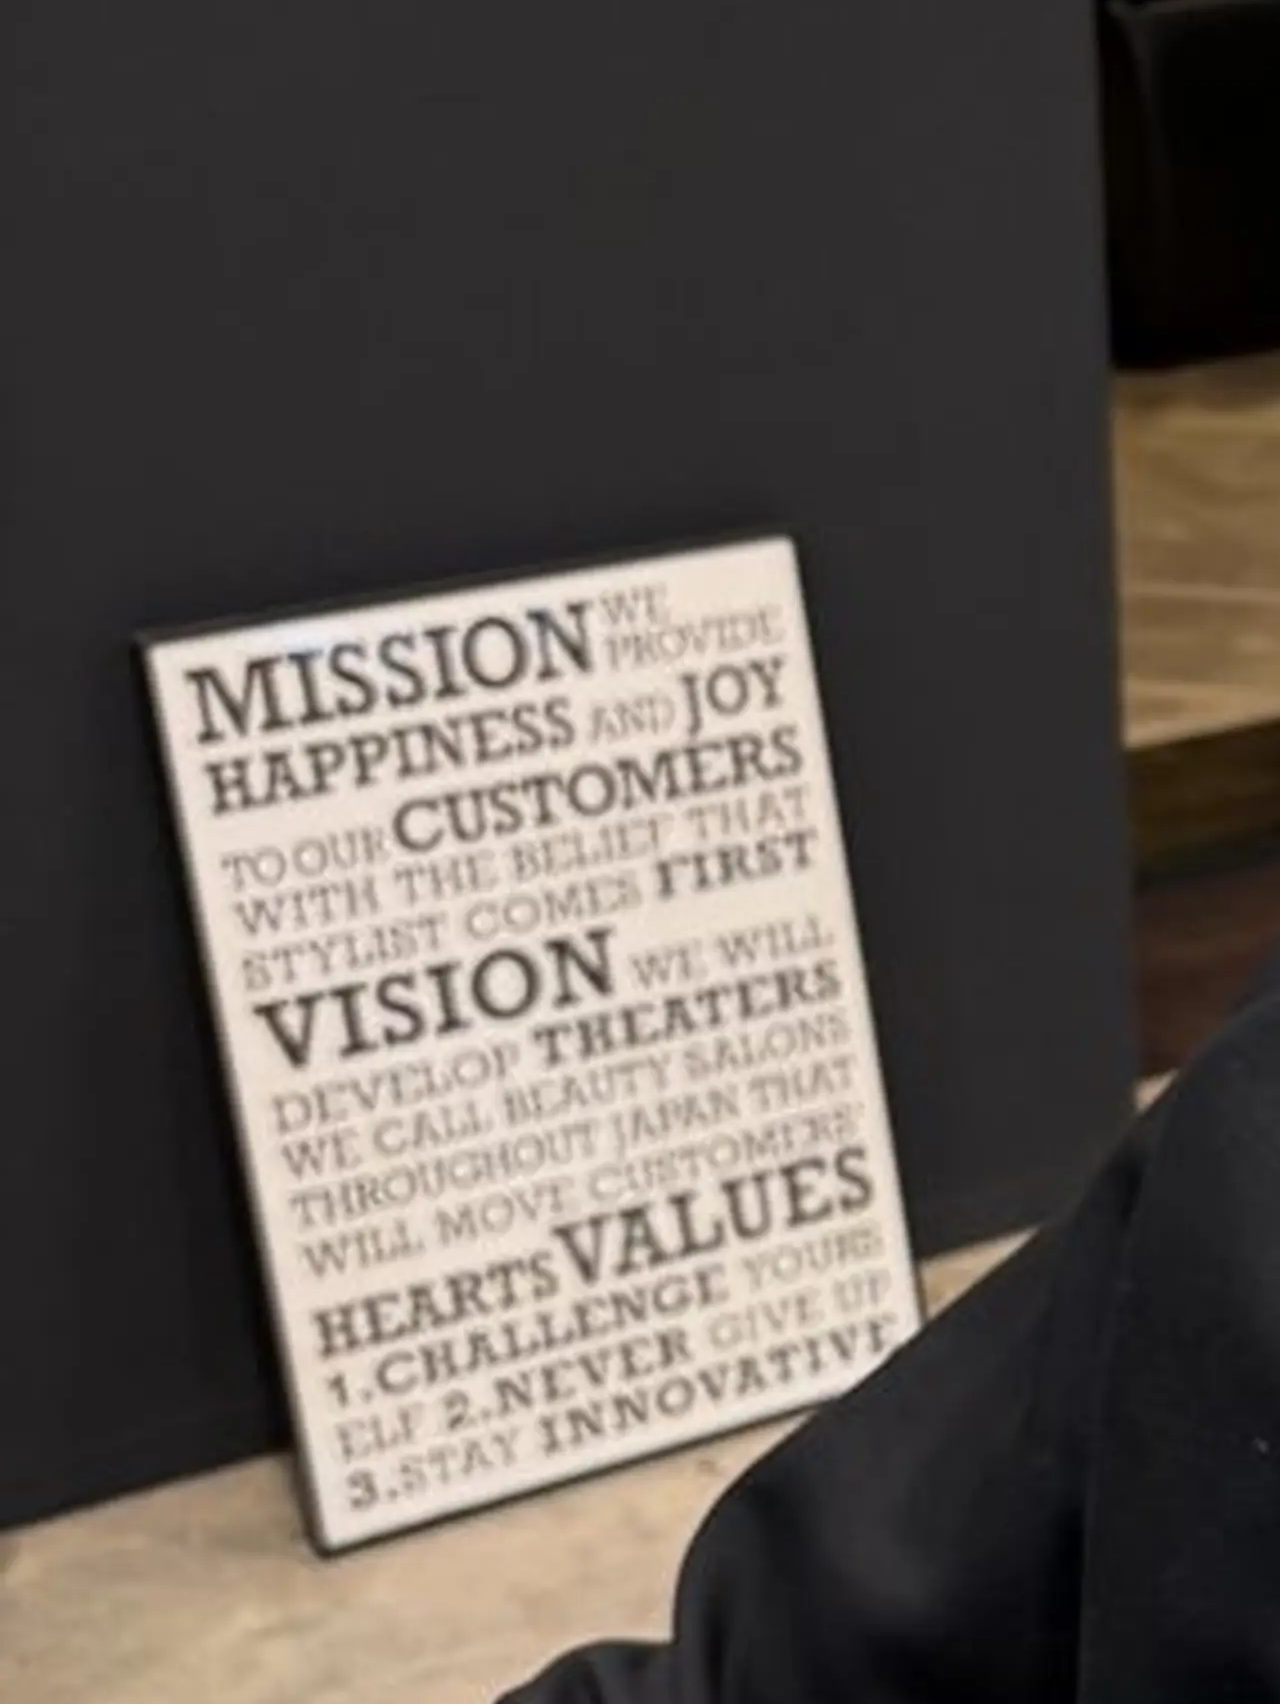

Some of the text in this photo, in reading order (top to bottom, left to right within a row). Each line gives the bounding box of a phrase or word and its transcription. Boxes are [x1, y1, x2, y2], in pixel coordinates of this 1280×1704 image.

[184, 582, 669, 744] MISSION WE
[606, 604, 786, 670] PROVIDE
[205, 655, 784, 815] HAPPINESS AND JOY
[221, 724, 803, 891] TO OUR CUSTOMERS
[233, 783, 809, 935] WITH THE BELIEF THAT
[242, 828, 818, 992] STYLIST COMES FIRST
[253, 913, 835, 1069] VISION WE WILL
[272, 959, 842, 1134] DEVELOP THEATERS
[281, 1013, 851, 1181] WE CALL BEAUTY SALONS
[289, 1054, 856, 1227] THROUGHOUT JAPAN THAT
[303, 1219, 426, 1278] WILL
[434, 1176, 577, 1244] MOVE
[312, 1145, 875, 1359] HEARTS VALUES
[335, 1399, 424, 1464] ELF
[708, 1288, 825, 1348] GIVE
[832, 1268, 891, 1314] UP
[536, 1311, 898, 1456] INNOVATIVE
